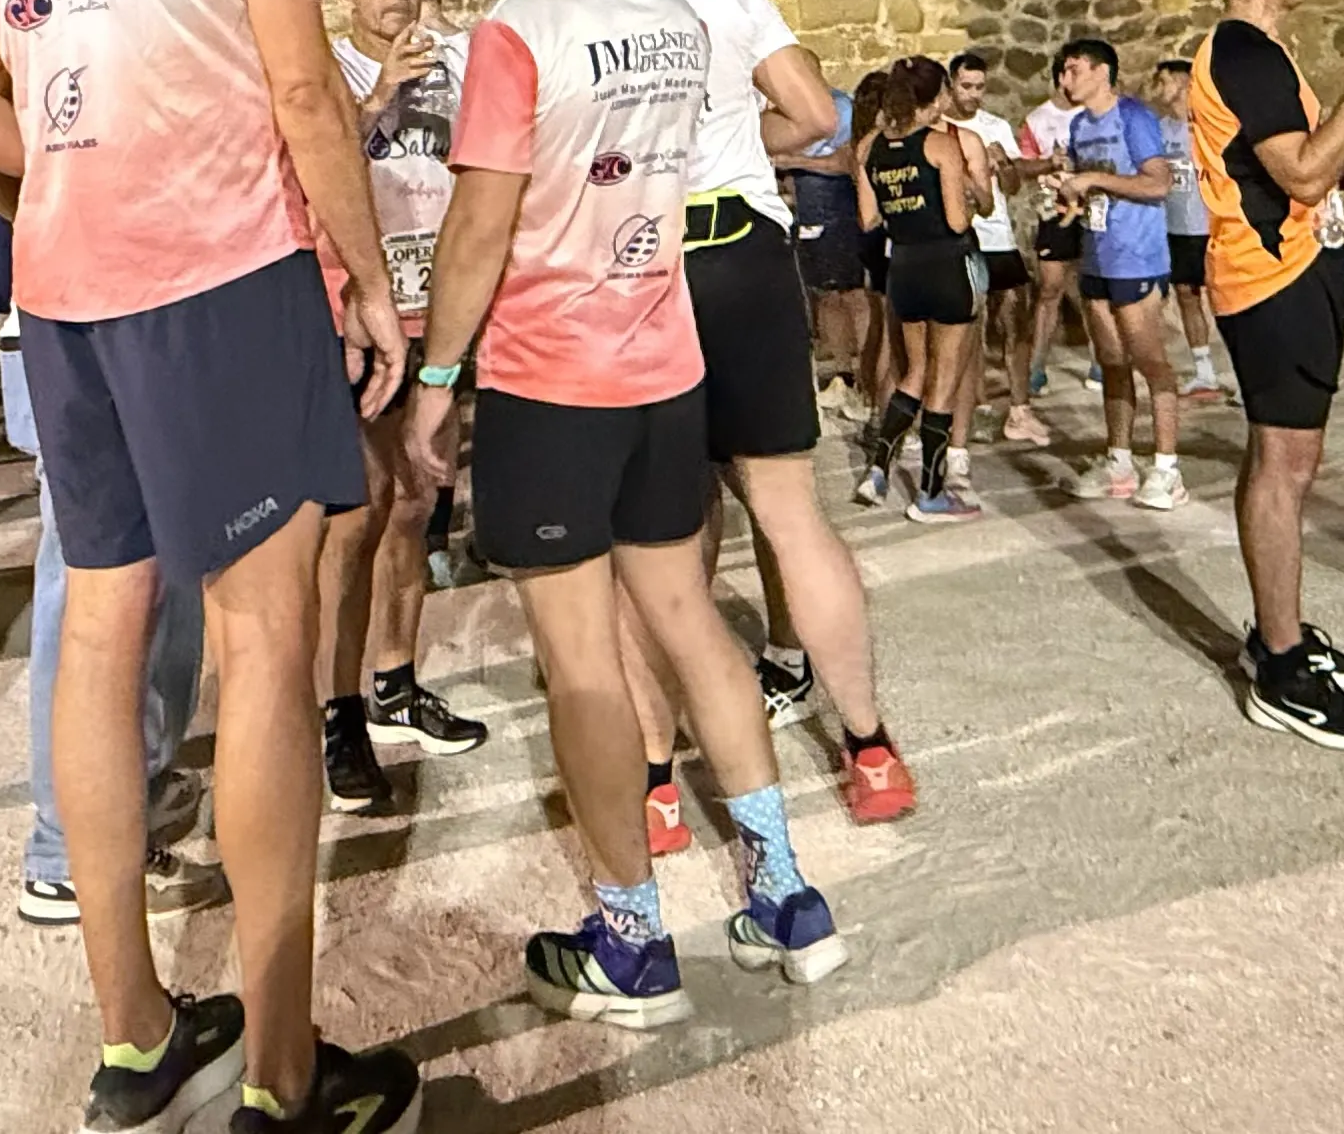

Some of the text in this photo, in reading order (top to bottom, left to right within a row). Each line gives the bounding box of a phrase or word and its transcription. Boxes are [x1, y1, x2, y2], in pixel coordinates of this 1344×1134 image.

[584, 38, 633, 87] JM
[638, 51, 705, 73] DENTAL
[224, 496, 280, 542] HOKA
